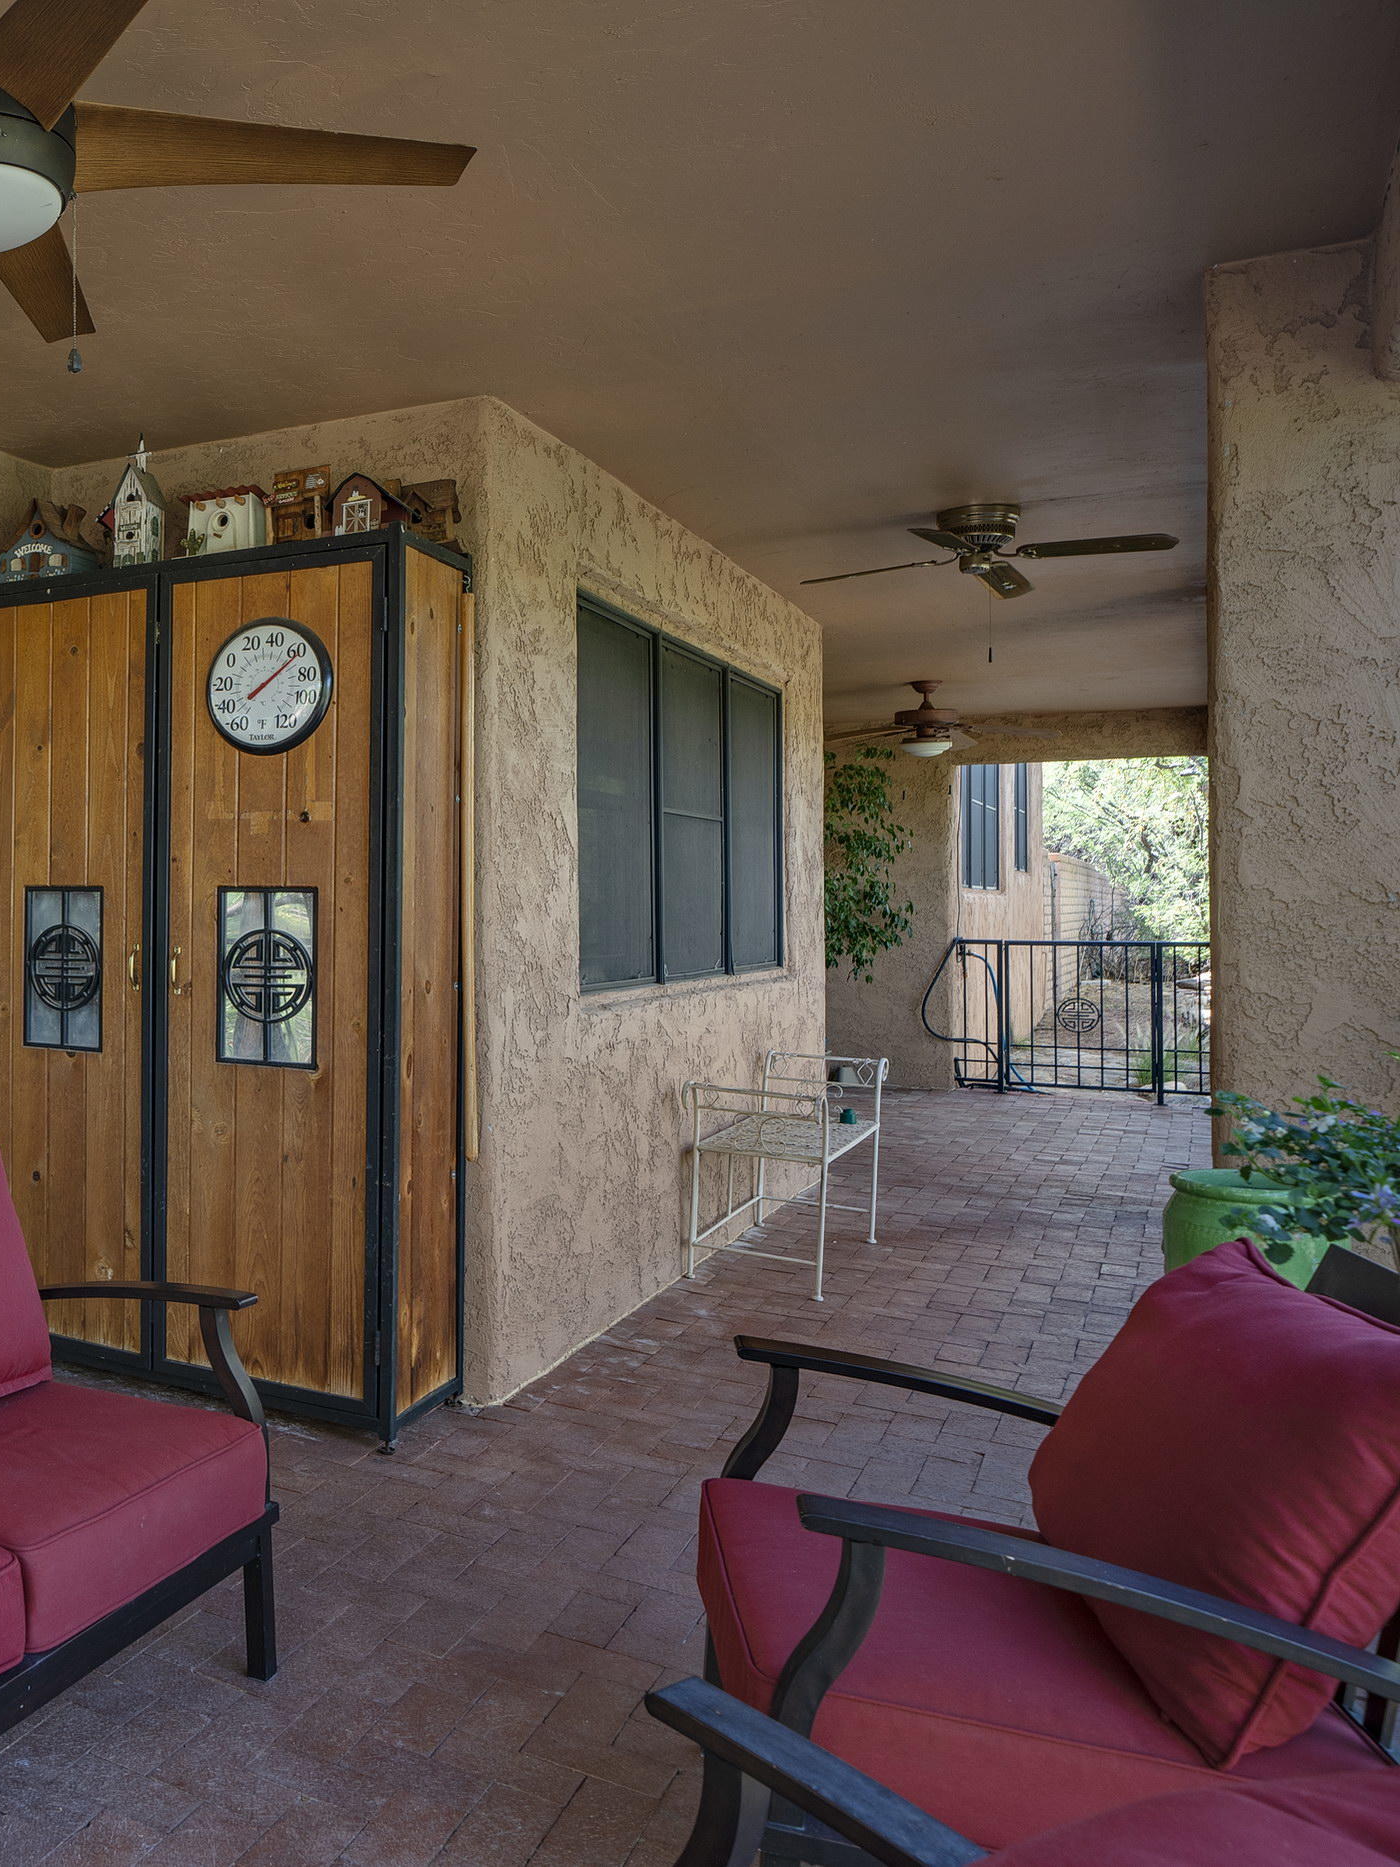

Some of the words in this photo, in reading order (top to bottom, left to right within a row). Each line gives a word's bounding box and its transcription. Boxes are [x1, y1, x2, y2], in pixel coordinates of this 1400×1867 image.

[12, 543, 54, 558] WELCOME
[242, 635, 261, 651] 20
[265, 631, 285, 648] 40
[287, 642, 306, 659] 60
[226, 653, 236, 668] 0
[297, 666, 317, 682] 80
[212, 676, 233, 692] -20
[295, 689, 317, 705] 100
[215, 699, 236, 714] -40
[225, 716, 249, 731] -60
[274, 714, 297, 729] 120
[249, 733, 275, 741] TAYLOR
